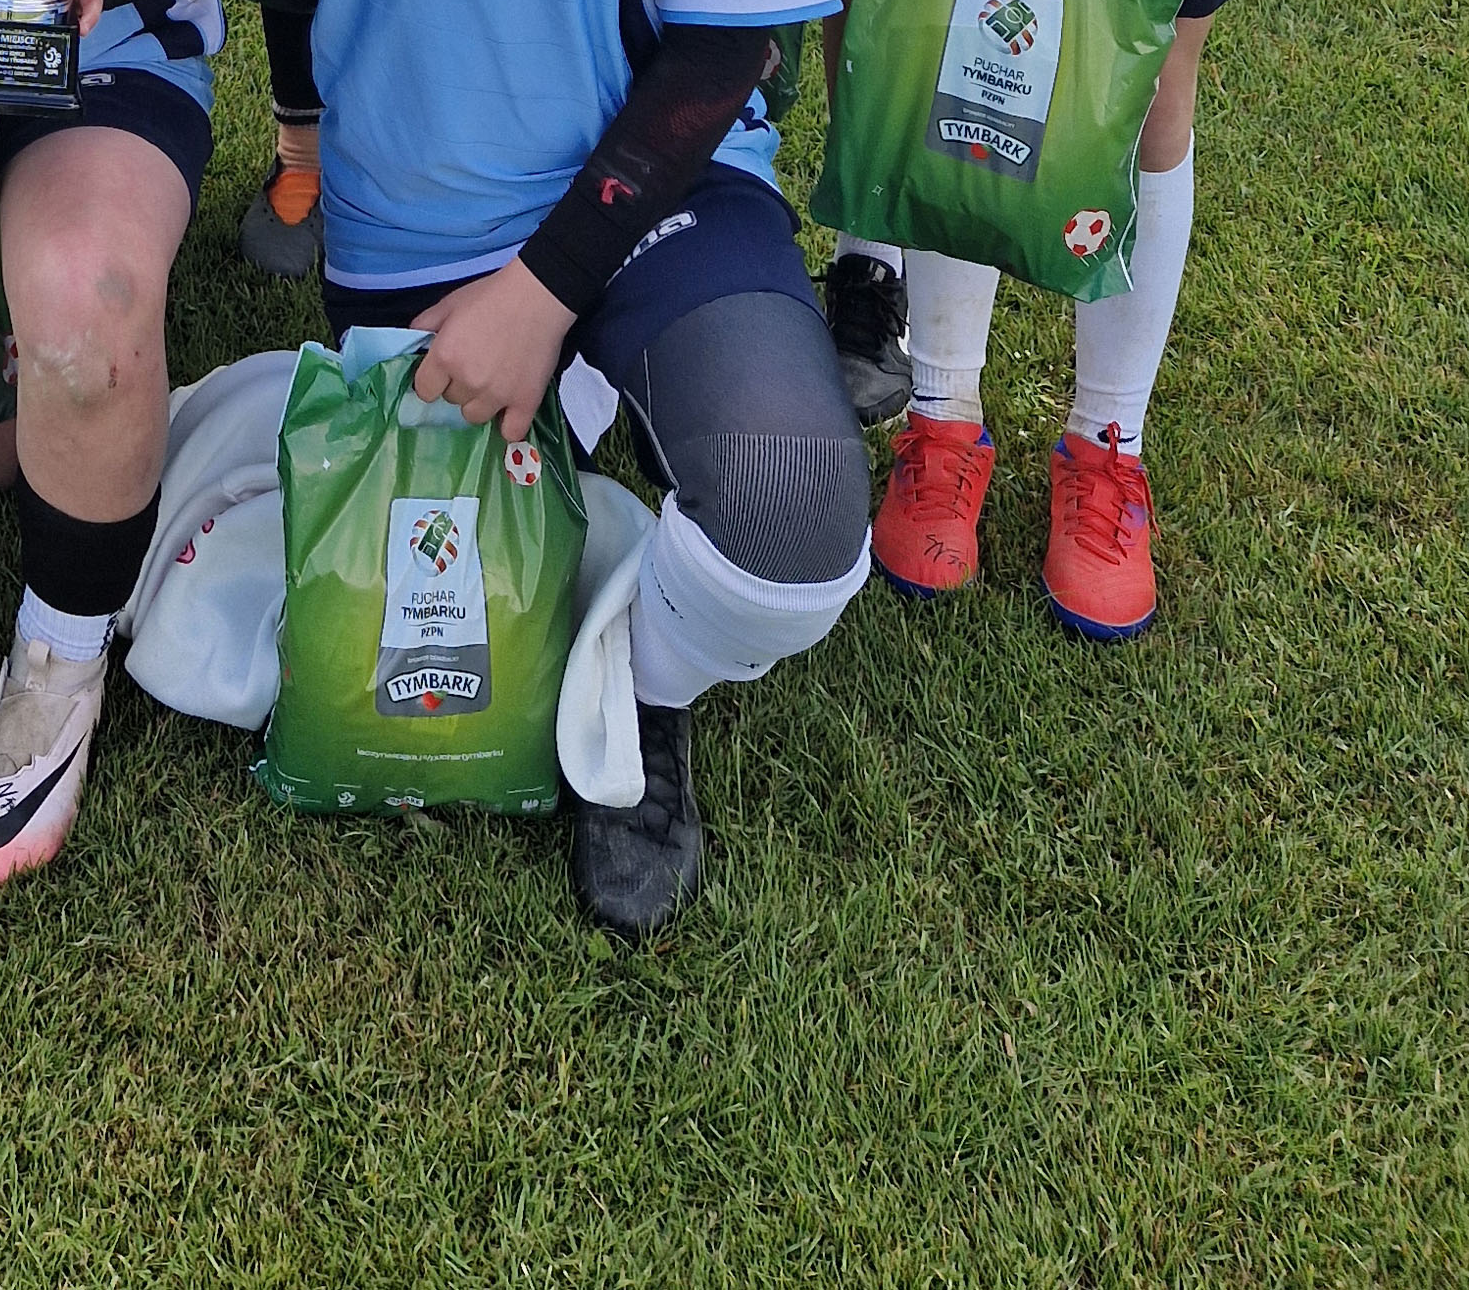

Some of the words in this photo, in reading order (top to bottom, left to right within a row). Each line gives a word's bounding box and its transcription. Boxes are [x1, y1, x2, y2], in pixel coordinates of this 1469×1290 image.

[973, 57, 1025, 82] PUCHAR
[962, 65, 1032, 95] TYMBARKU
[981, 89, 1006, 105] PZPN
[944, 122, 1025, 159] TYMBARK
[411, 590, 456, 605] PUCHAR
[401, 605, 466, 620] TYMBARKU
[420, 626, 444, 638] PZPN
[392, 673, 476, 696] TYMBARK
